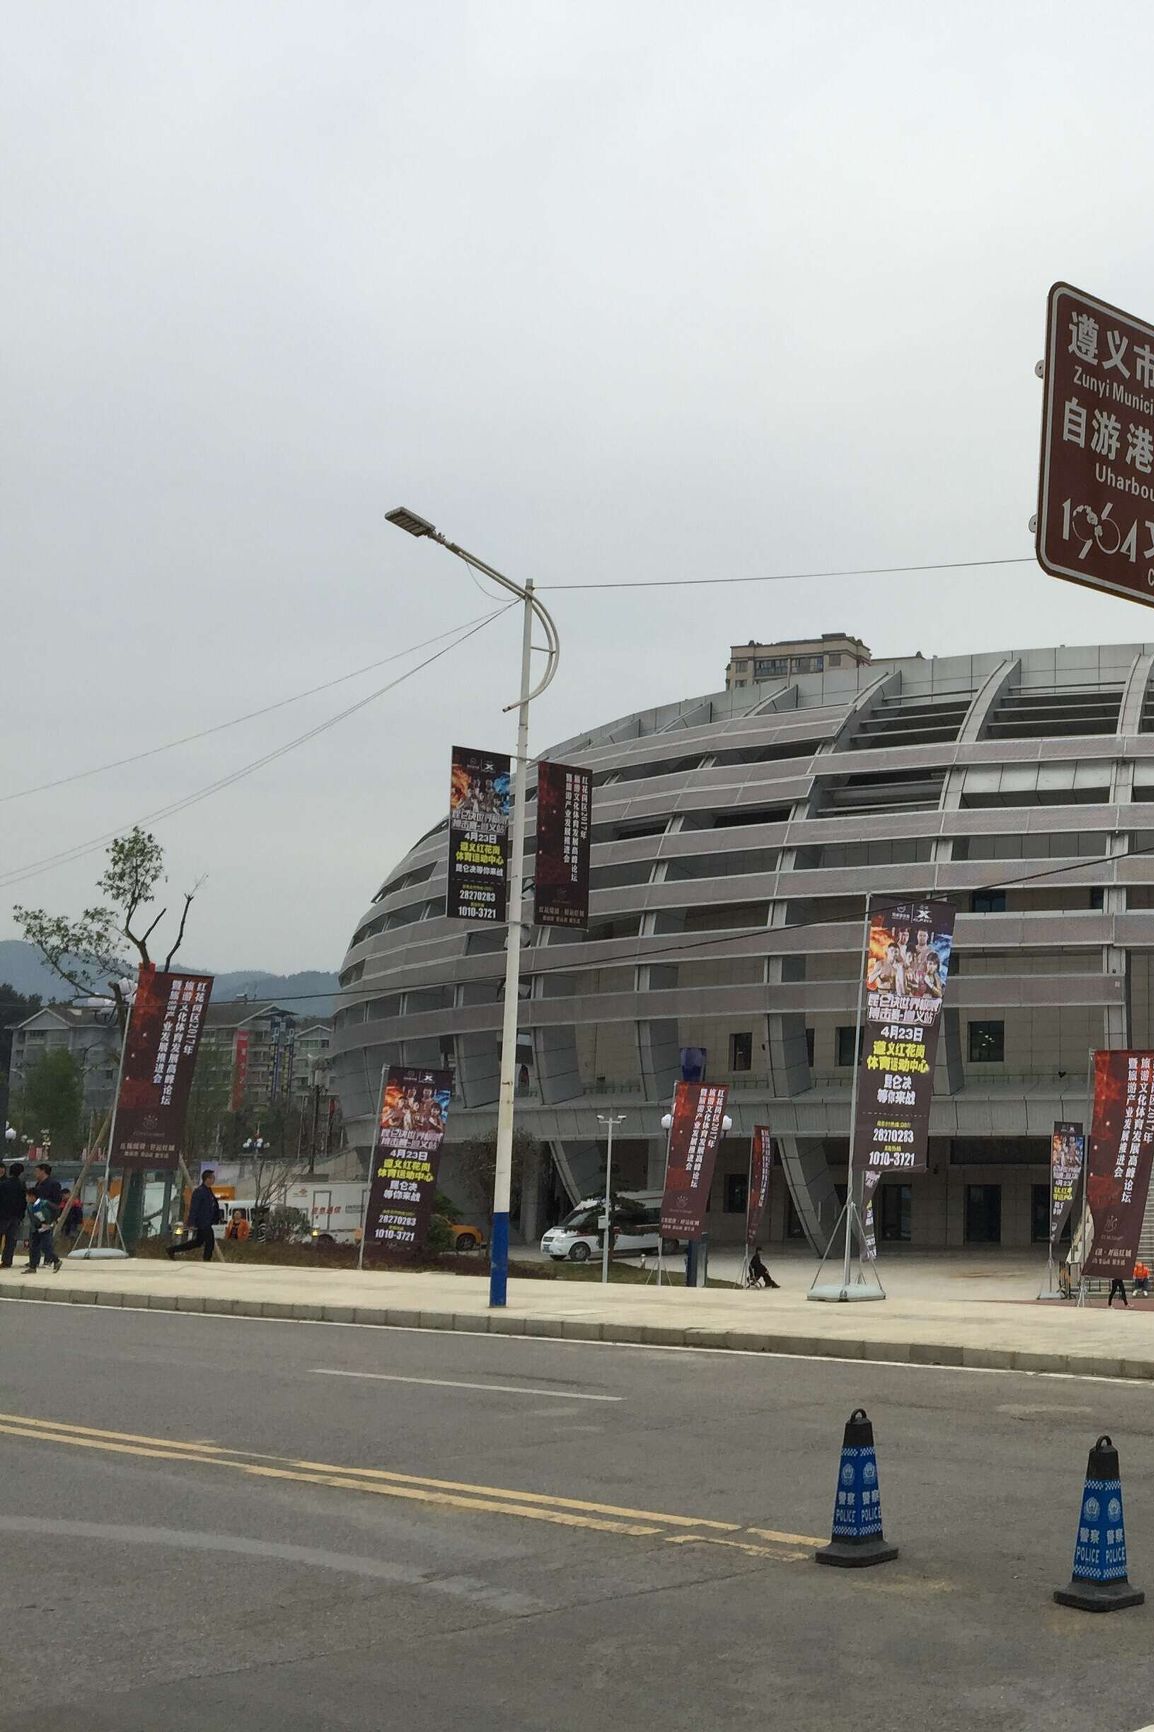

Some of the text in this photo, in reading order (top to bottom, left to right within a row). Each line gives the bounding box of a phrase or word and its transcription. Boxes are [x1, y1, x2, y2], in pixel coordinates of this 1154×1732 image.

[1073, 365, 1110, 398] Zunyi
[464, 831, 497, 844] 4月23日
[458, 905, 497, 919] 1010-3721
[880, 1024, 924, 1042] 4月23日
[866, 1055, 931, 1074] 体育运动中心
[1120, 1056, 1151, 1204] 旅游文化体育发展高峰论坛
[390, 1150, 429, 1161] 4月23日
[868, 1151, 916, 1167] 1010-3721
[374, 1228, 416, 1242] 1010-3721
[838, 1491, 855, 1506] 警察
[836, 1508, 856, 1523] POLICE
[861, 1506, 882, 1522] POLICE
[1080, 1527, 1100, 1543] 警察
[1076, 1546, 1100, 1564] POLICE
[1105, 1546, 1126, 1563] POLICE
